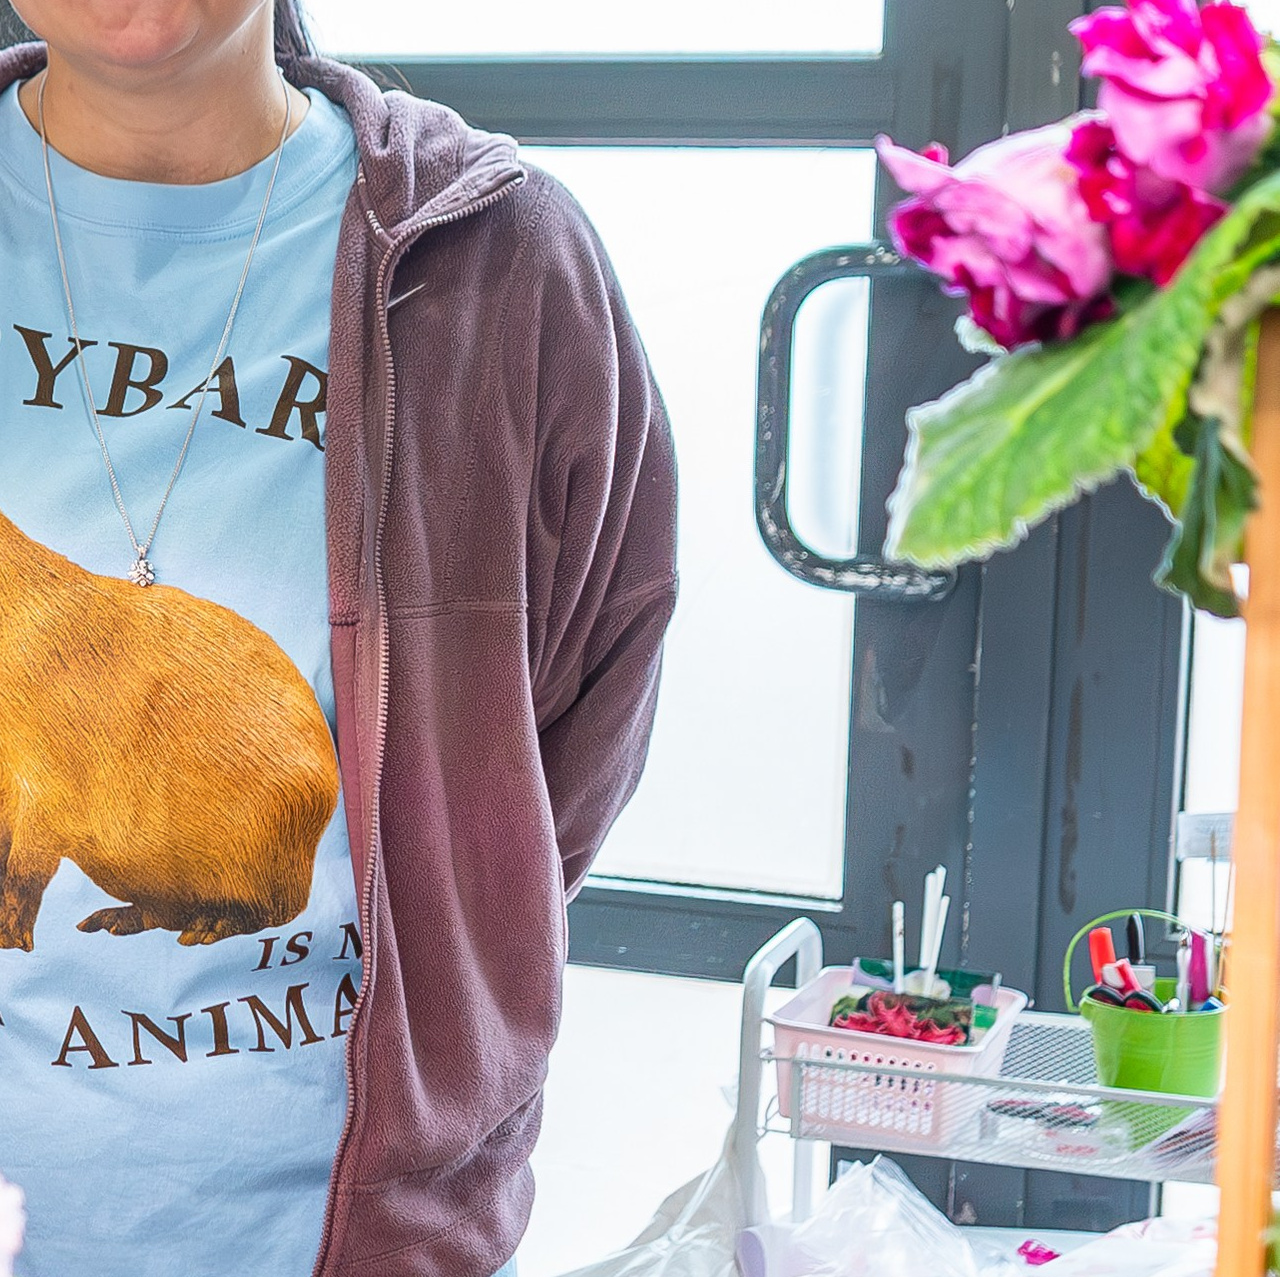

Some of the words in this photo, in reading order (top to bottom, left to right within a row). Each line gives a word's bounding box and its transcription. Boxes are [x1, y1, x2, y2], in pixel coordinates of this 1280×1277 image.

[366, 210, 385, 235] NIKE
[251, 930, 314, 973] IS
[51, 972, 362, 1070] ANIMA
